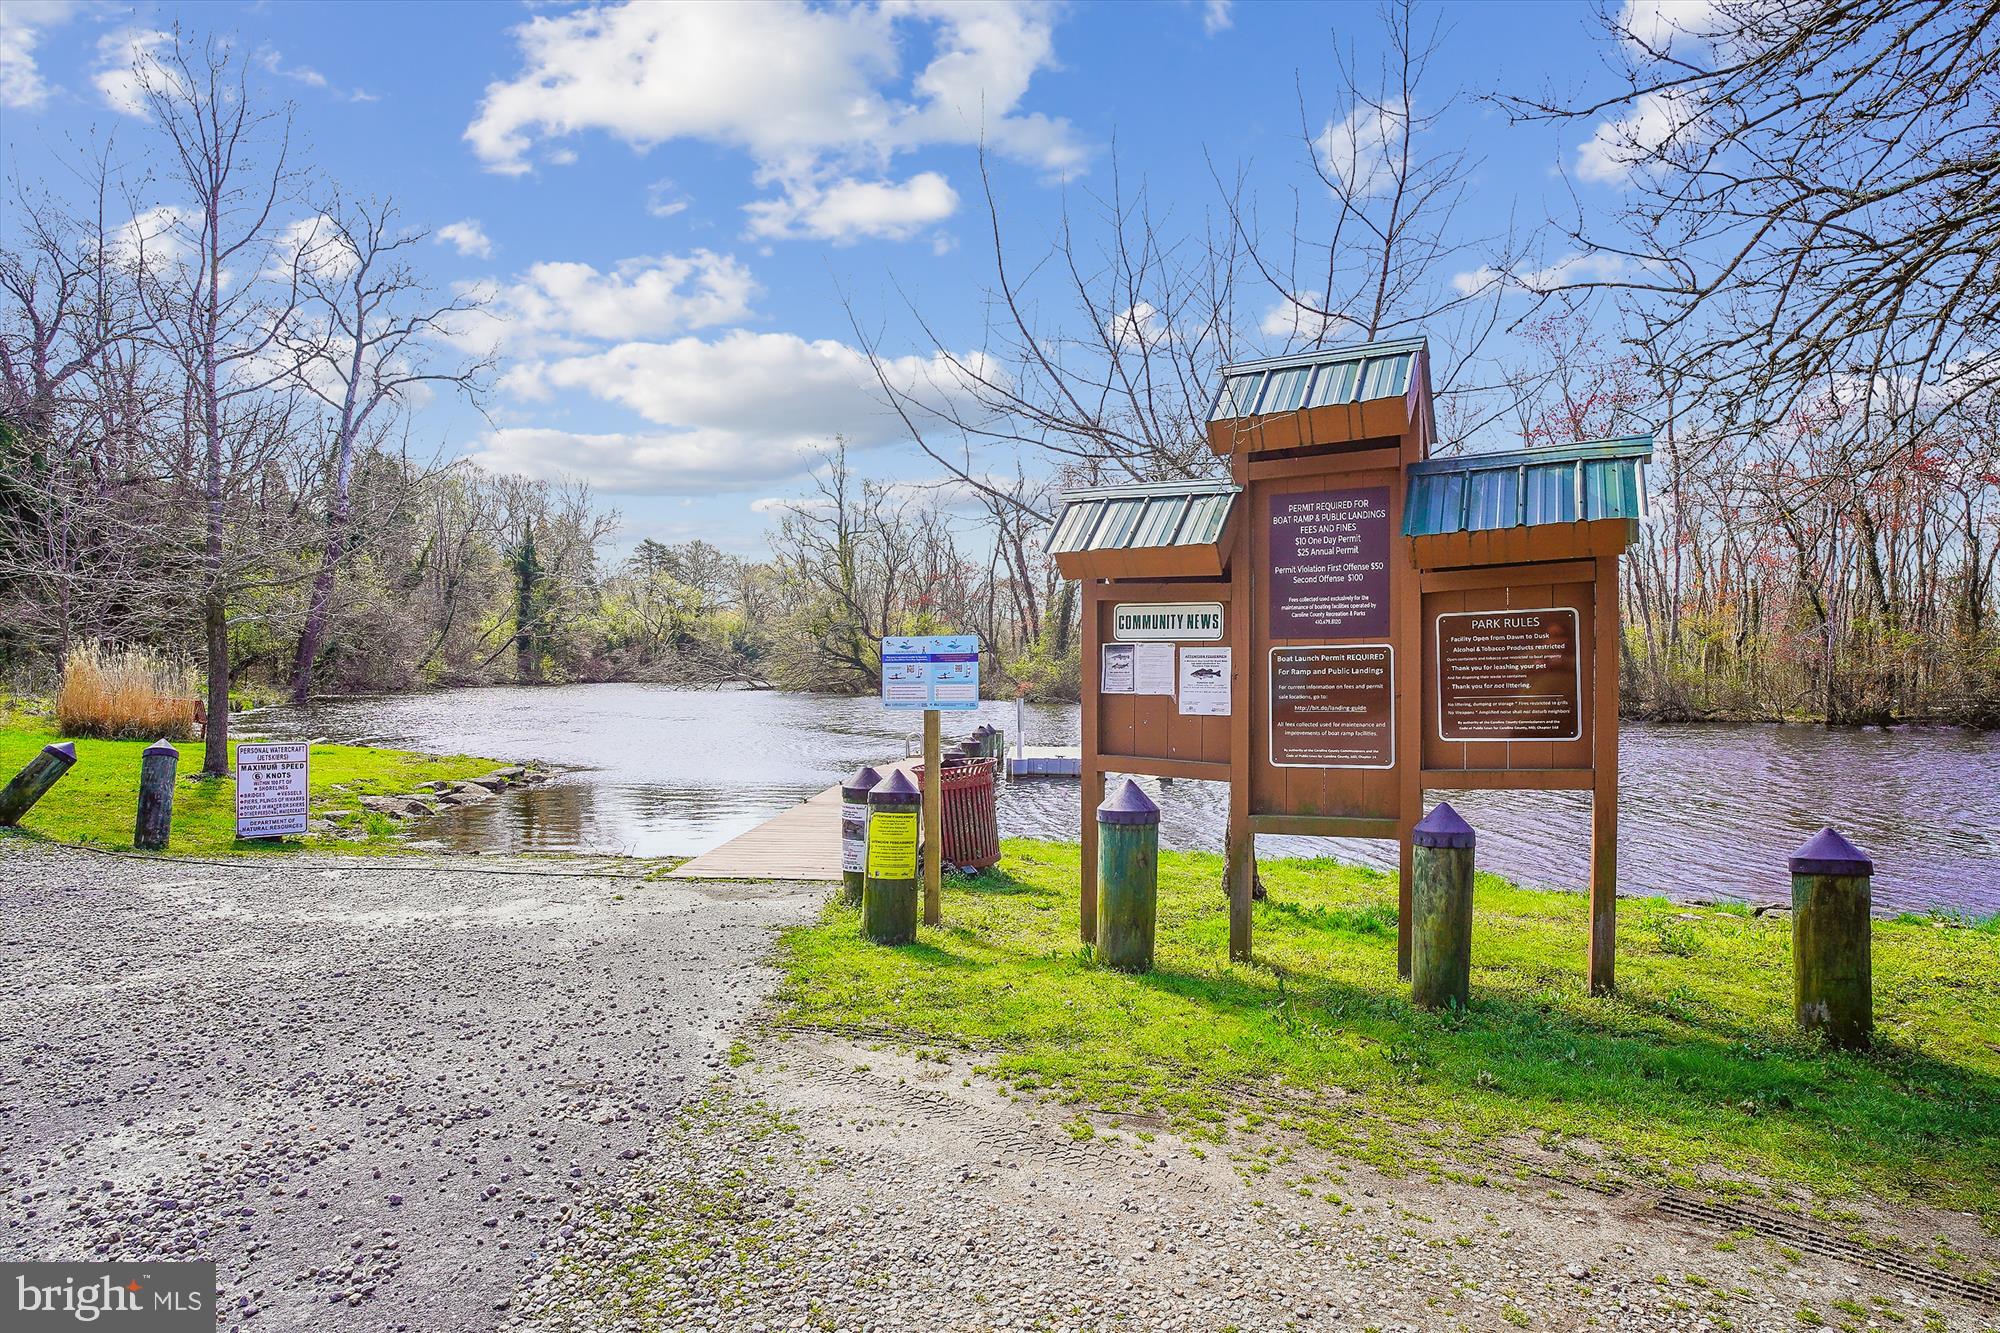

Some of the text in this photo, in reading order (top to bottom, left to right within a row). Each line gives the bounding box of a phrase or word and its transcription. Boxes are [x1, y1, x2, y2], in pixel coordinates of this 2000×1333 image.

[1289, 504, 1314, 512] PERMIT
[1316, 501, 1352, 511] REQUIRED
[1273, 516, 1291, 524] BOAT
[1293, 515, 1313, 523] RAMP
[1322, 513, 1347, 521] PUBLIC
[1348, 510, 1385, 519] LANDINGS
[1336, 523, 1356, 532] FINES
[1295, 537, 1306, 545] $10
[1324, 536, 1336, 545] Day
[1338, 534, 1361, 543] Permit
[1297, 546, 1359, 556] $25 Annual Permit
[1297, 564, 1326, 573] Violation
[1343, 563, 1369, 571] Offense
[1119, 614, 1218, 629] COMMUNITY NEWS
[1472, 617, 1540, 629] PARK RULES
